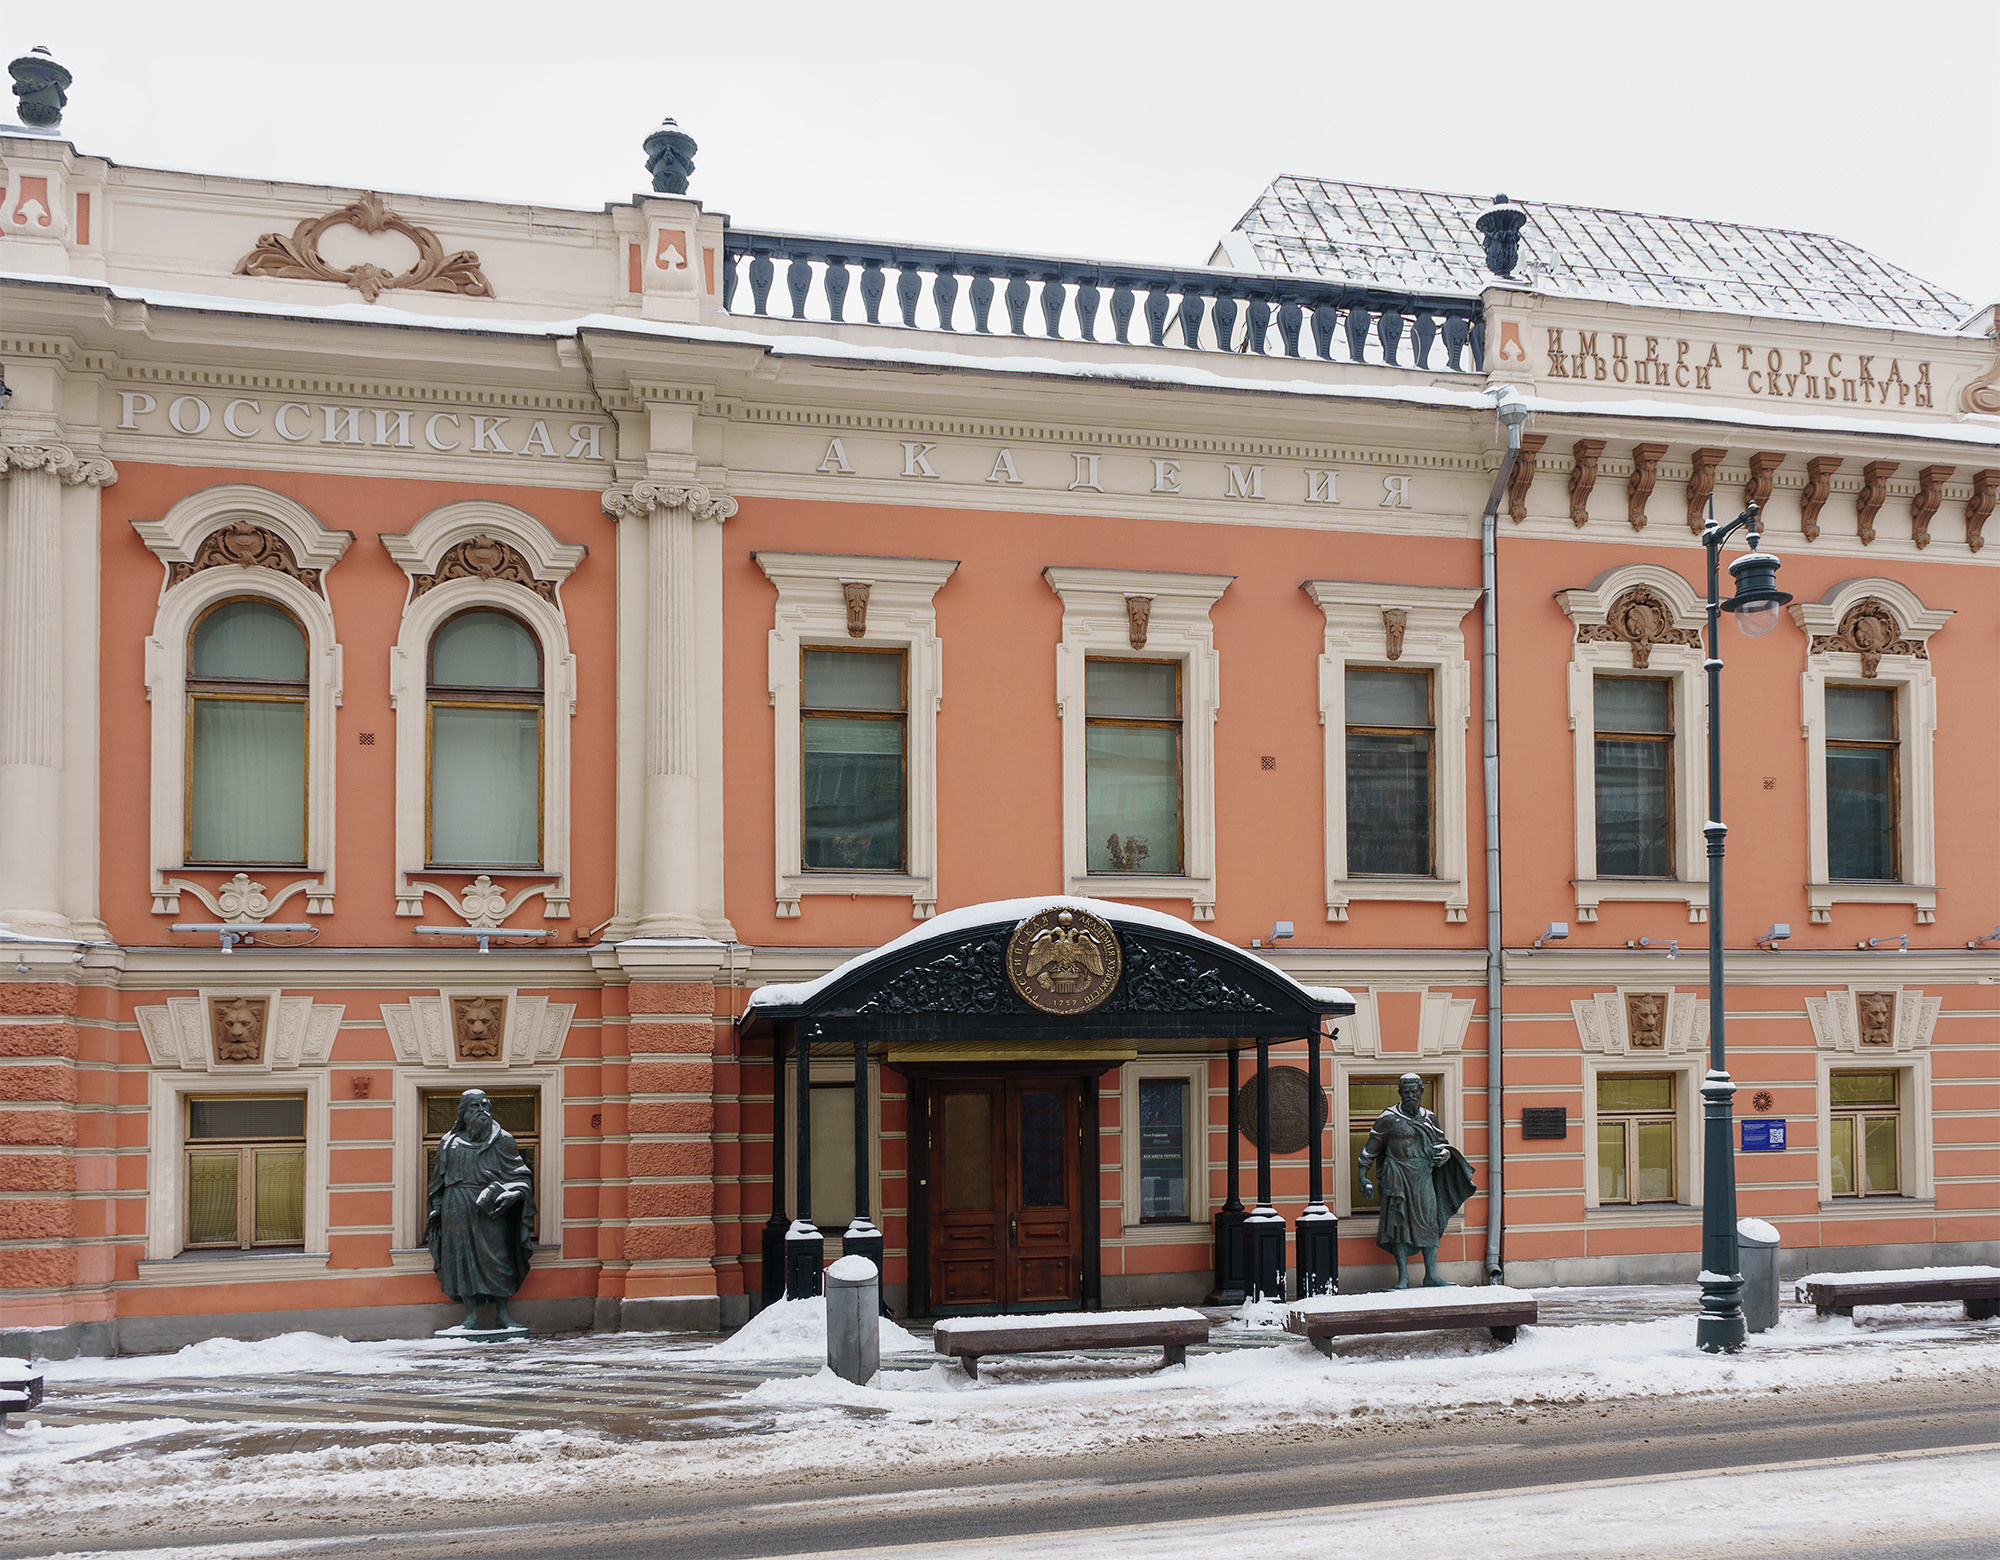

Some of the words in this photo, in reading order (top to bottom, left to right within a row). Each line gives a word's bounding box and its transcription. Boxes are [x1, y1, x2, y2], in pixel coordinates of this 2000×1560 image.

[1547, 328, 1932, 386] ИМПЕРАТОРСКАЯ
[1547, 353, 1712, 389] ЖИВОПИСИ
[1748, 370, 1934, 408] СКУЛЬПТУРЫ
[816, 437, 1413, 510] АКАДЕМИЯ
[1079, 916, 1116, 956] АКАДЕМИЯ
[1084, 959, 1116, 1004] ХУДОЖЕСТВ
